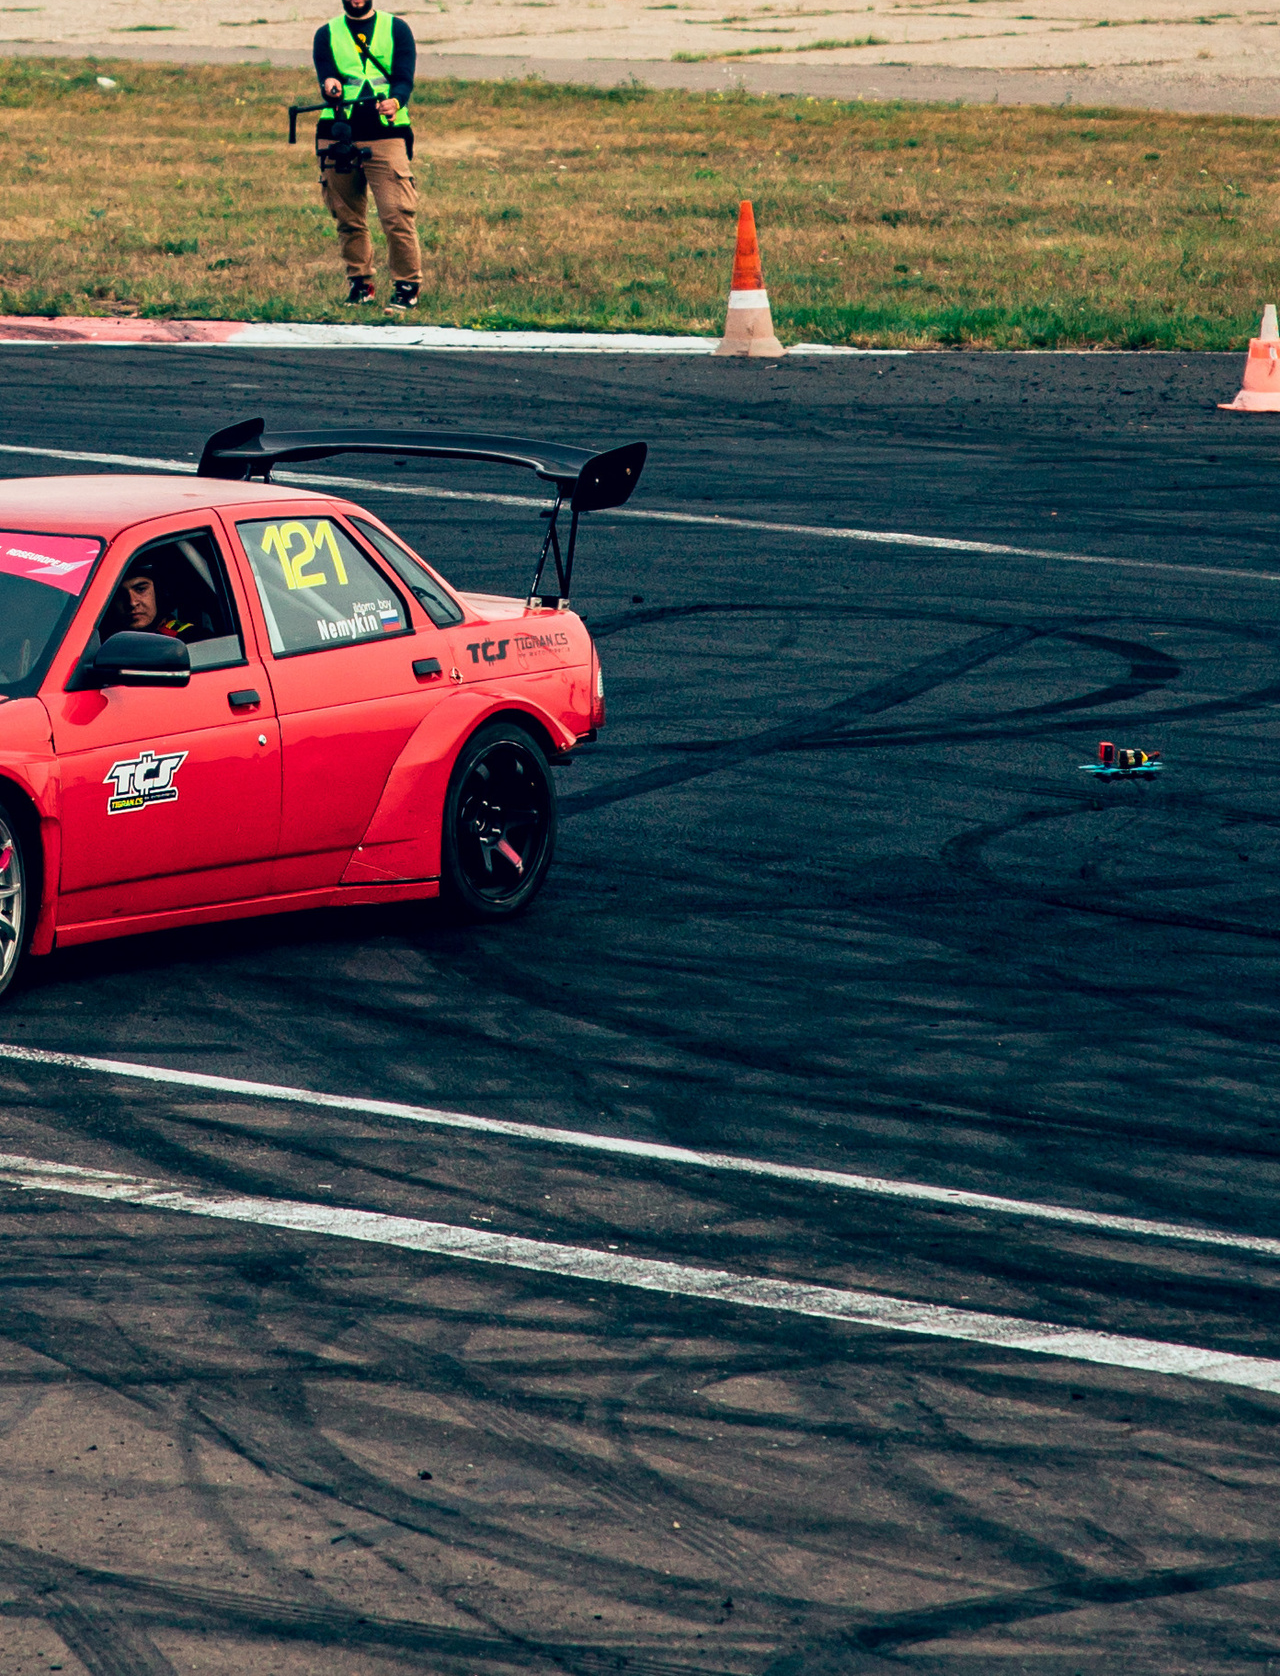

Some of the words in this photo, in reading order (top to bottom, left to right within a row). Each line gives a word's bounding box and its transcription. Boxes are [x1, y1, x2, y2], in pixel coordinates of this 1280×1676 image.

[261, 520, 348, 590] 121
[317, 612, 378, 640] Nemykin
[467, 638, 510, 666] TCS
[112, 756, 180, 795] TCS
